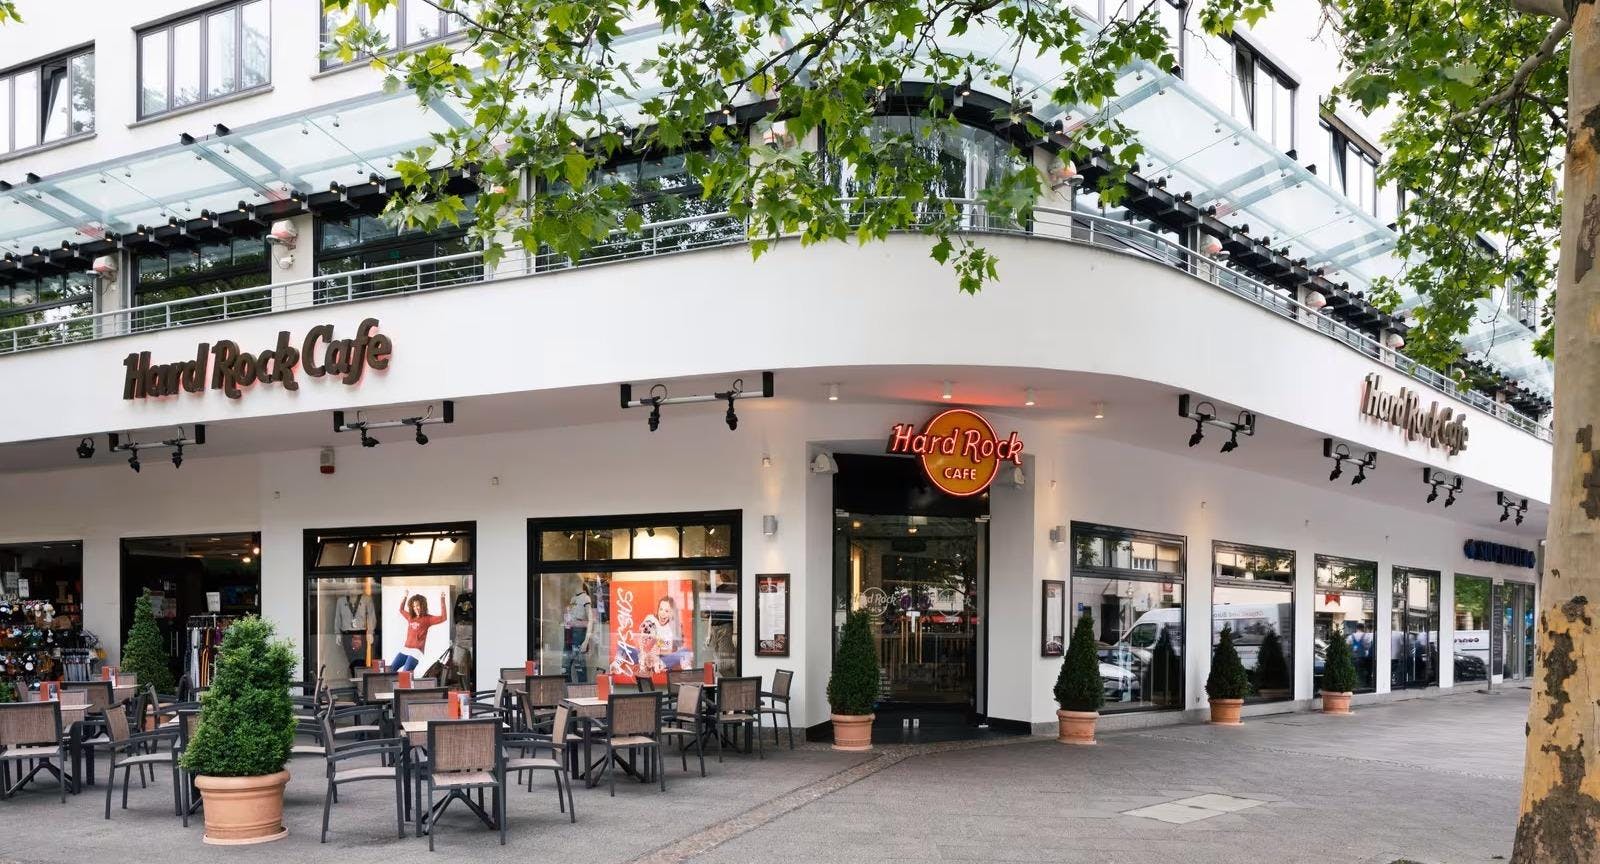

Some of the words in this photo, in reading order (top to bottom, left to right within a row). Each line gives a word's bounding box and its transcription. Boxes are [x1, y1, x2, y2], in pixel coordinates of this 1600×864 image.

[123, 343, 209, 400] Hard
[211, 331, 299, 399] Rock
[302, 317, 392, 385] Cafe
[890, 423, 960, 454] Hard
[963, 429, 1024, 465] Rock
[1362, 372, 1408, 427] Hard
[1404, 390, 1440, 448] Rock
[1437, 407, 1470, 456] Cafe
[944, 467, 977, 480] CAFE
